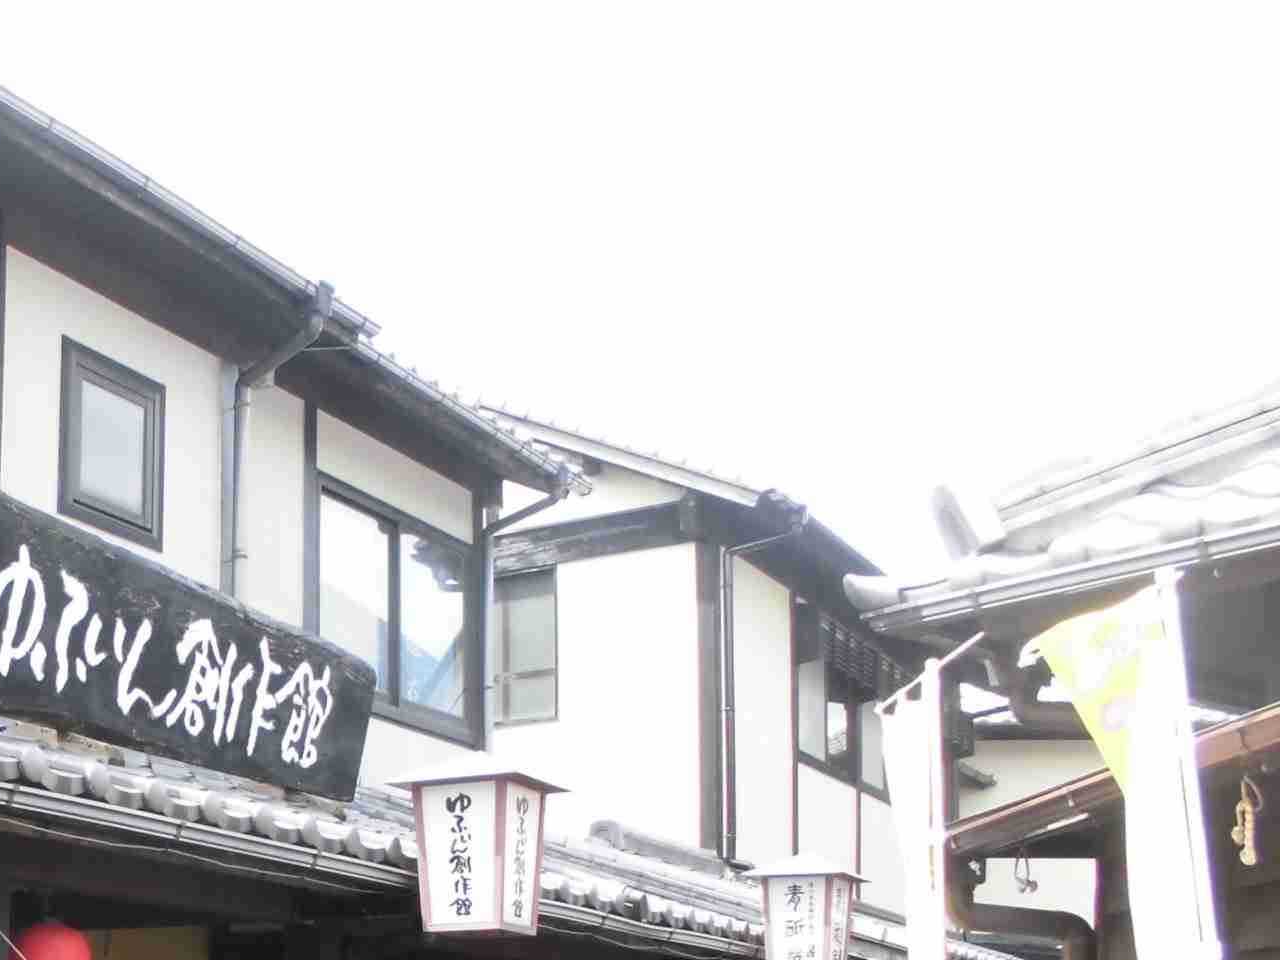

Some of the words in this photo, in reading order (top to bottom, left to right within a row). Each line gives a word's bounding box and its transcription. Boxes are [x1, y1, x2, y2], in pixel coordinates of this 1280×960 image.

[445, 792, 473, 917] ゆふいん創作館
